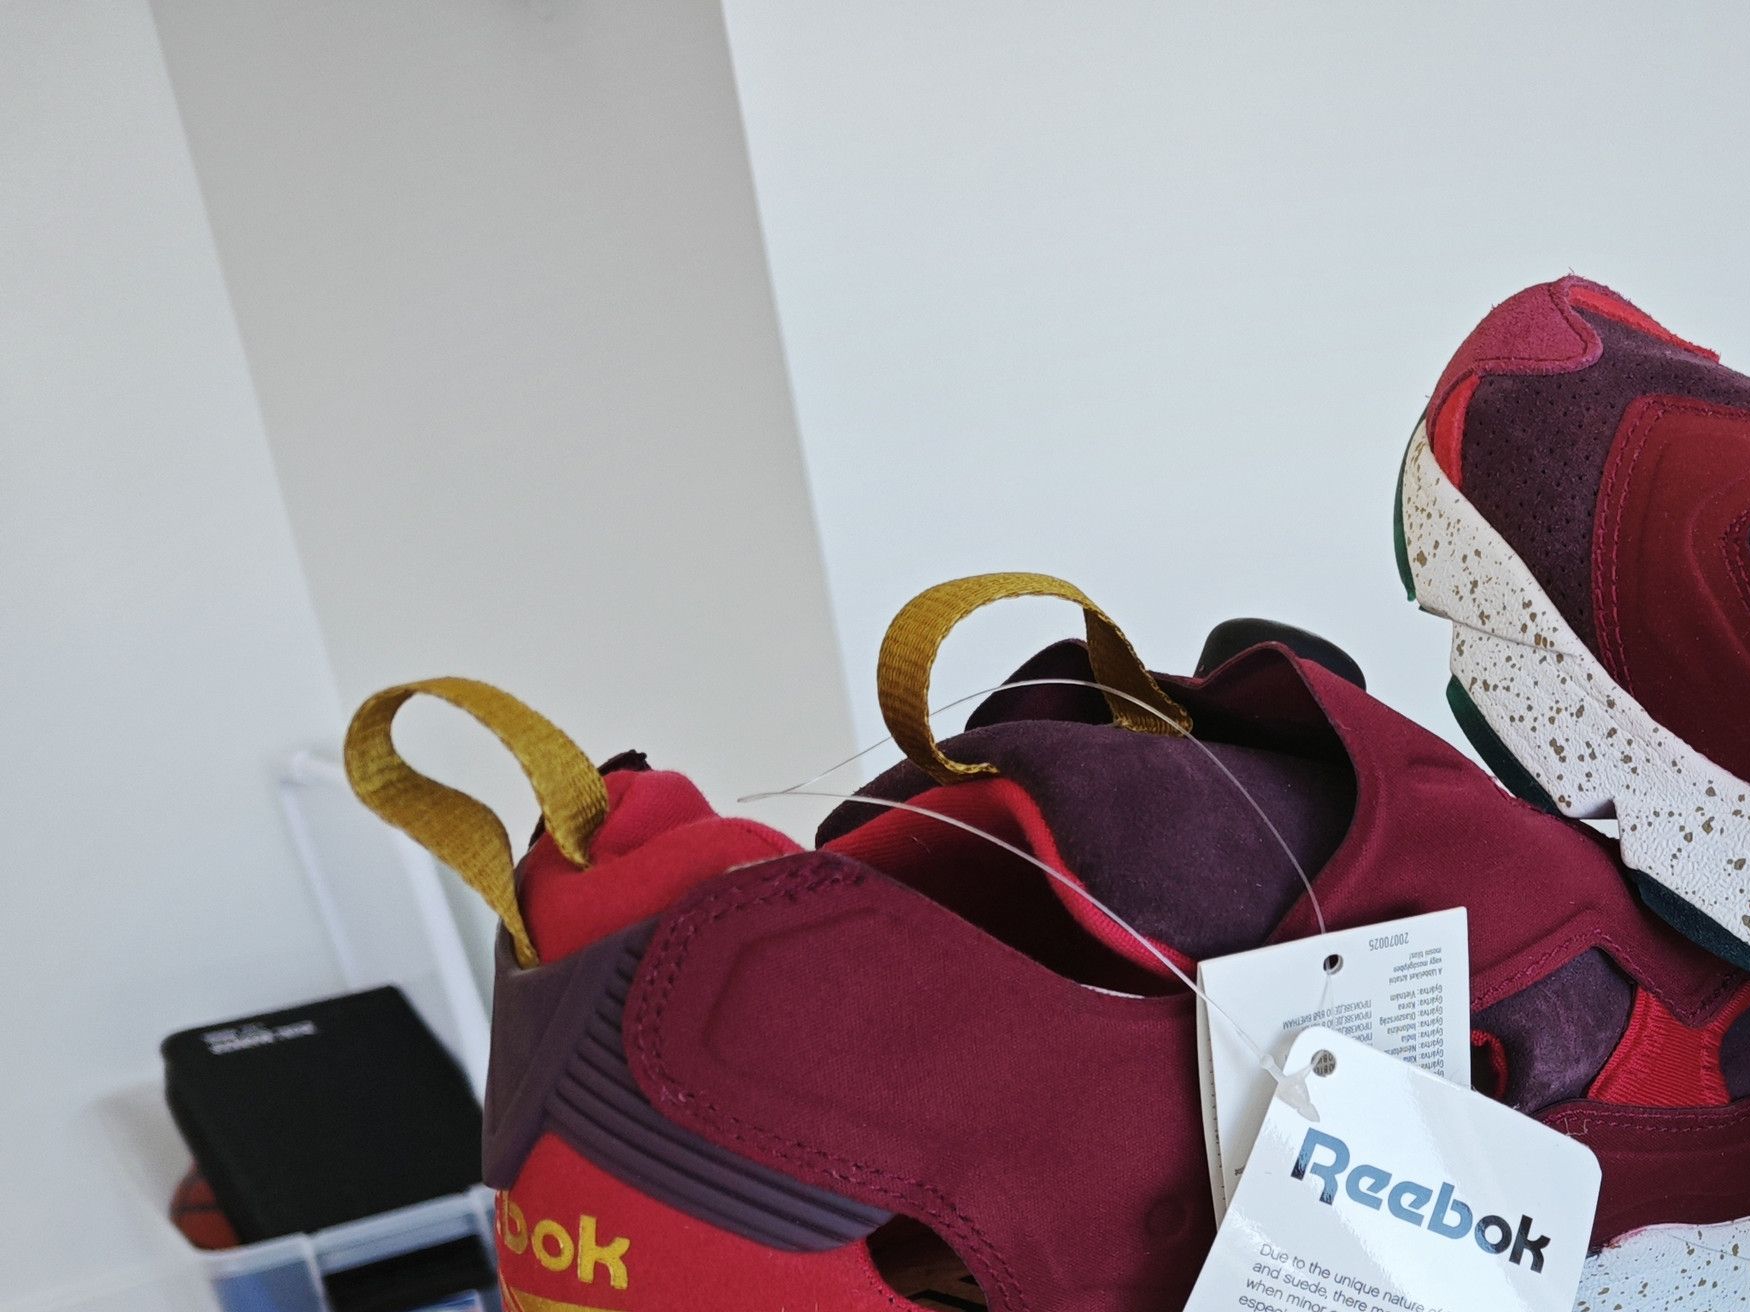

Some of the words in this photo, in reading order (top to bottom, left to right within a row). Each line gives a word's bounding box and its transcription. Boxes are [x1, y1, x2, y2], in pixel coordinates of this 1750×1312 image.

[1369, 932, 1409, 951] 20070025
[1398, 1001, 1416, 1010] Korea
[1401, 1033, 1416, 1043] India
[1290, 1127, 1551, 1274] Reebok
[501, 1190, 631, 1290] bok
[1252, 1262, 1282, 1279] and
[1282, 1271, 1327, 1299] suede,
[1332, 1290, 1367, 1311] there
[1259, 1242, 1289, 1263] Due
[1292, 1256, 1305, 1269] to
[1308, 1261, 1330, 1279] the
[1333, 1273, 1380, 1297] unique
[1246, 1278, 1283, 1300] when
